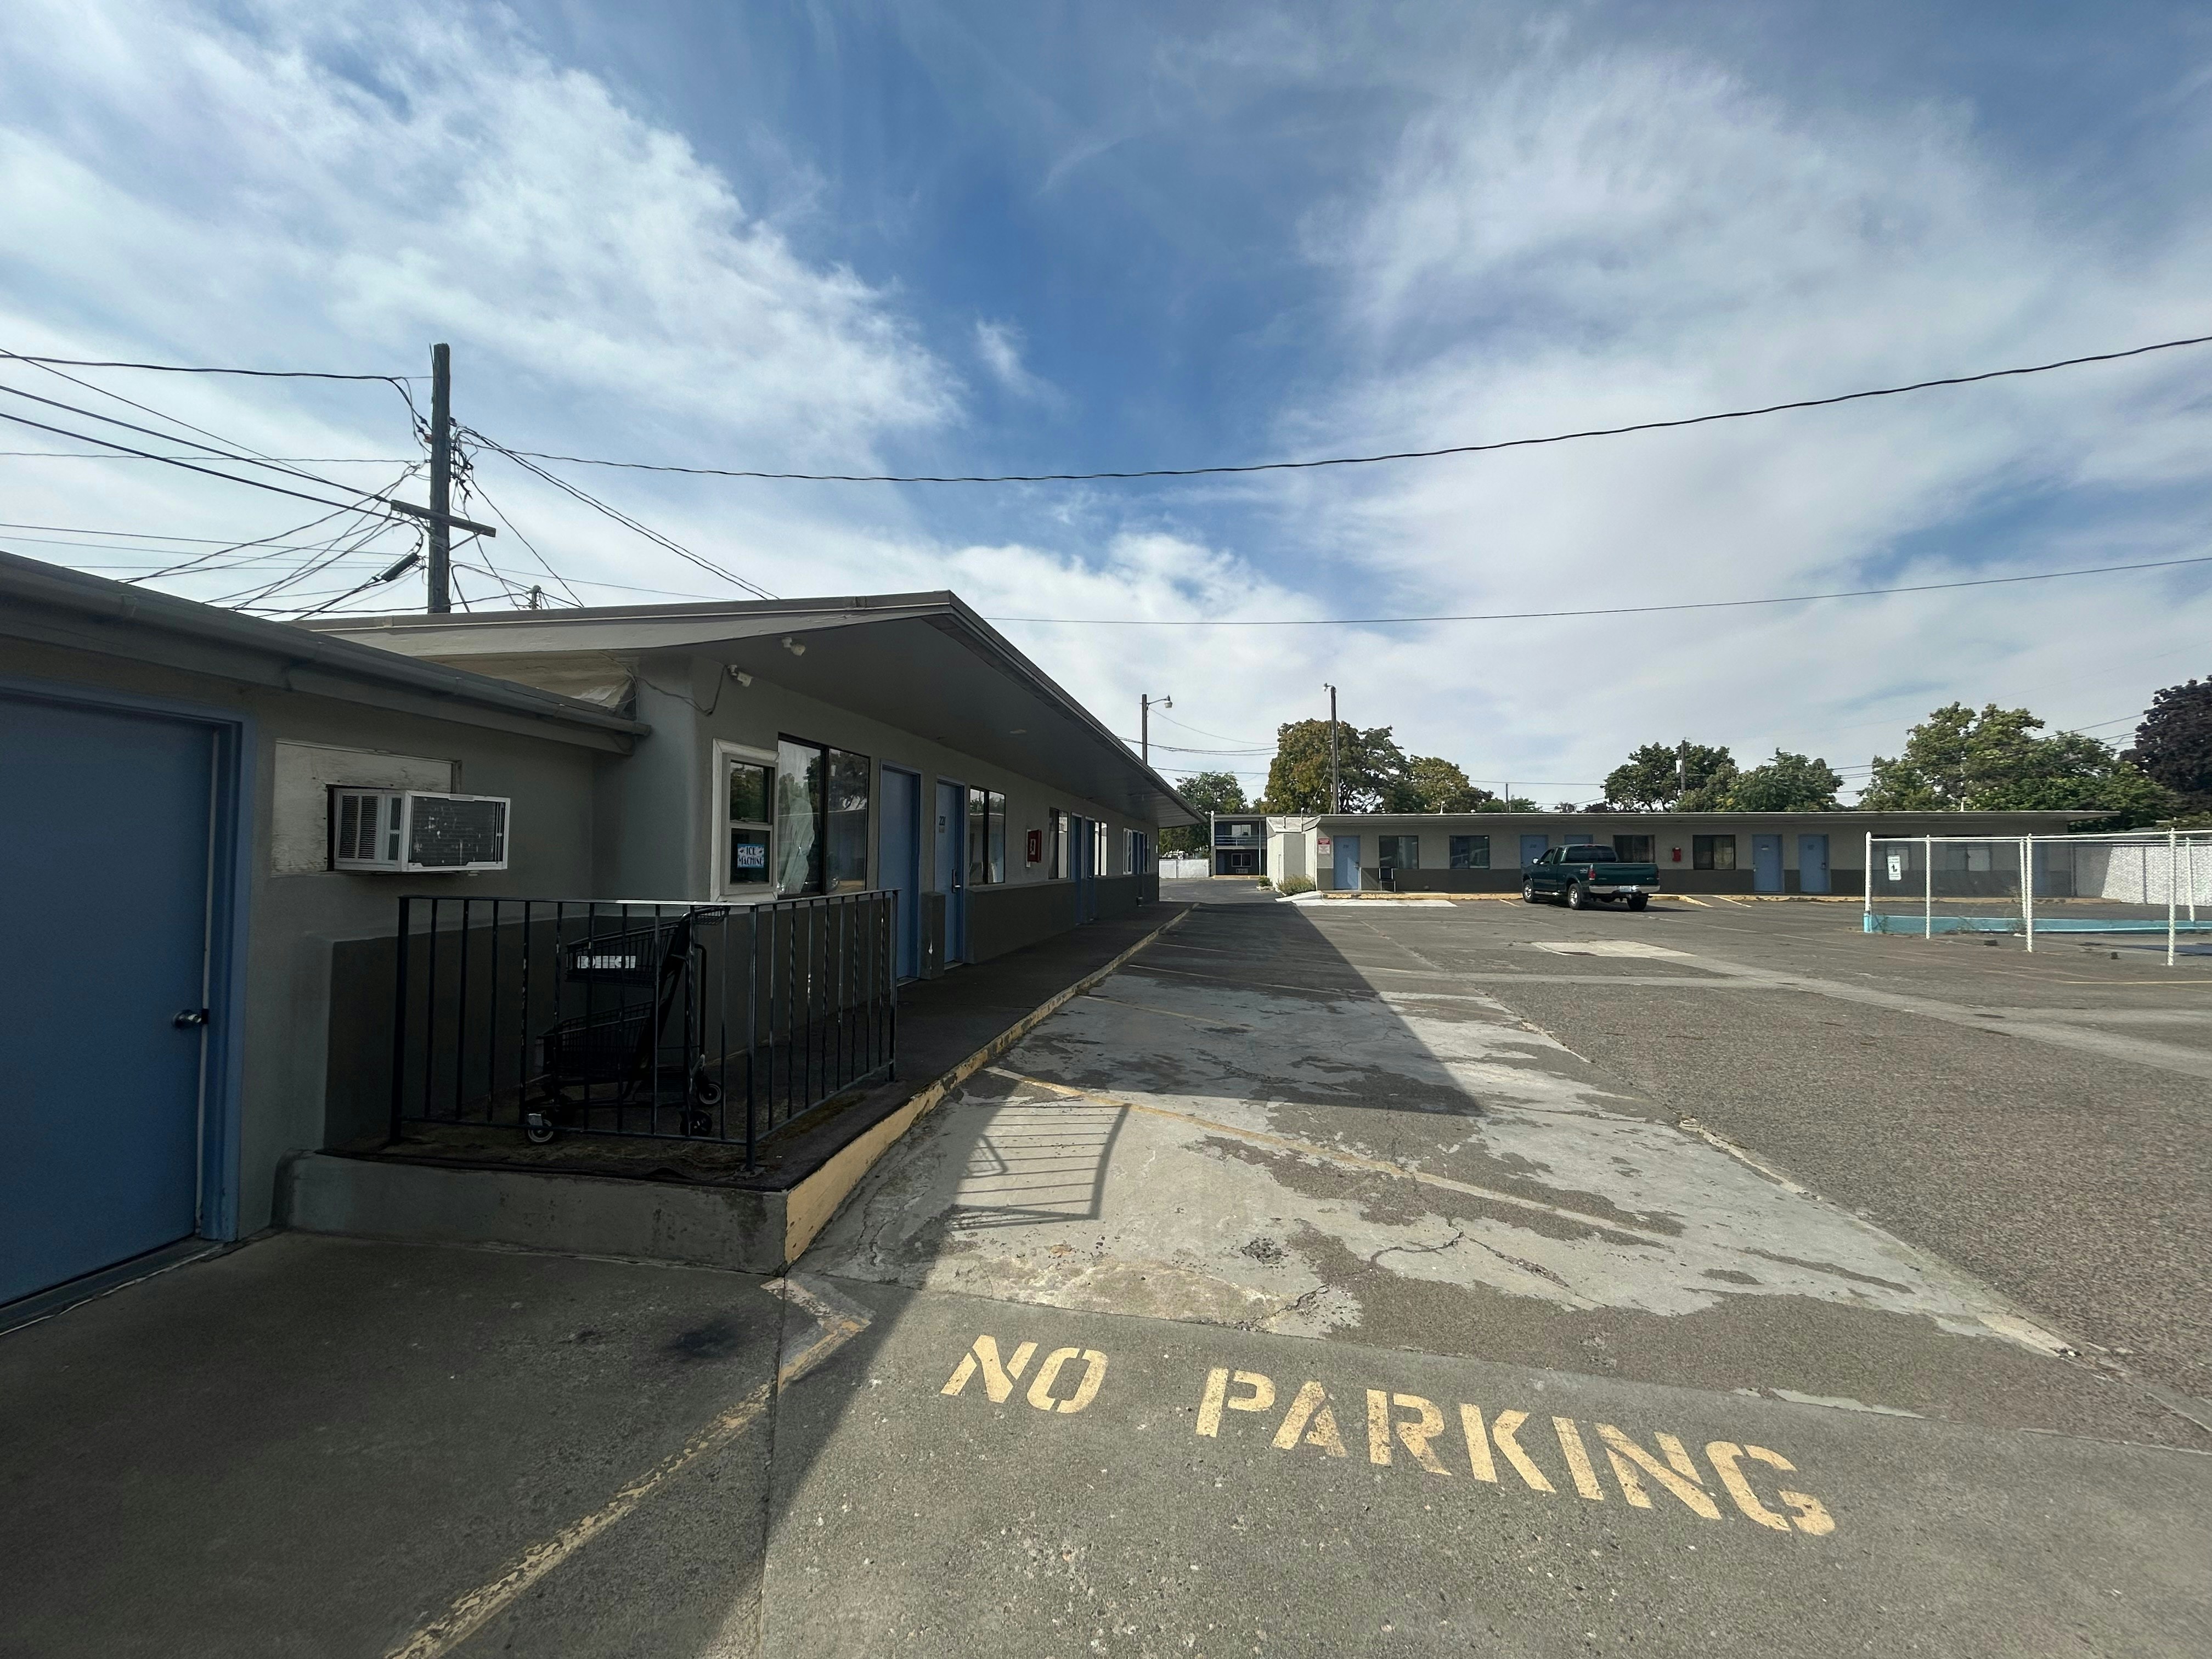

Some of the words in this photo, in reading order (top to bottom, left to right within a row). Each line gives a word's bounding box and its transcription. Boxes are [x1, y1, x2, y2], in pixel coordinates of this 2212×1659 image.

[746, 847, 757, 855] ICE
[738, 857, 763, 865] MACHINE
[940, 1335, 1109, 1414] NO
[1195, 1368, 1836, 1536] PARKING
